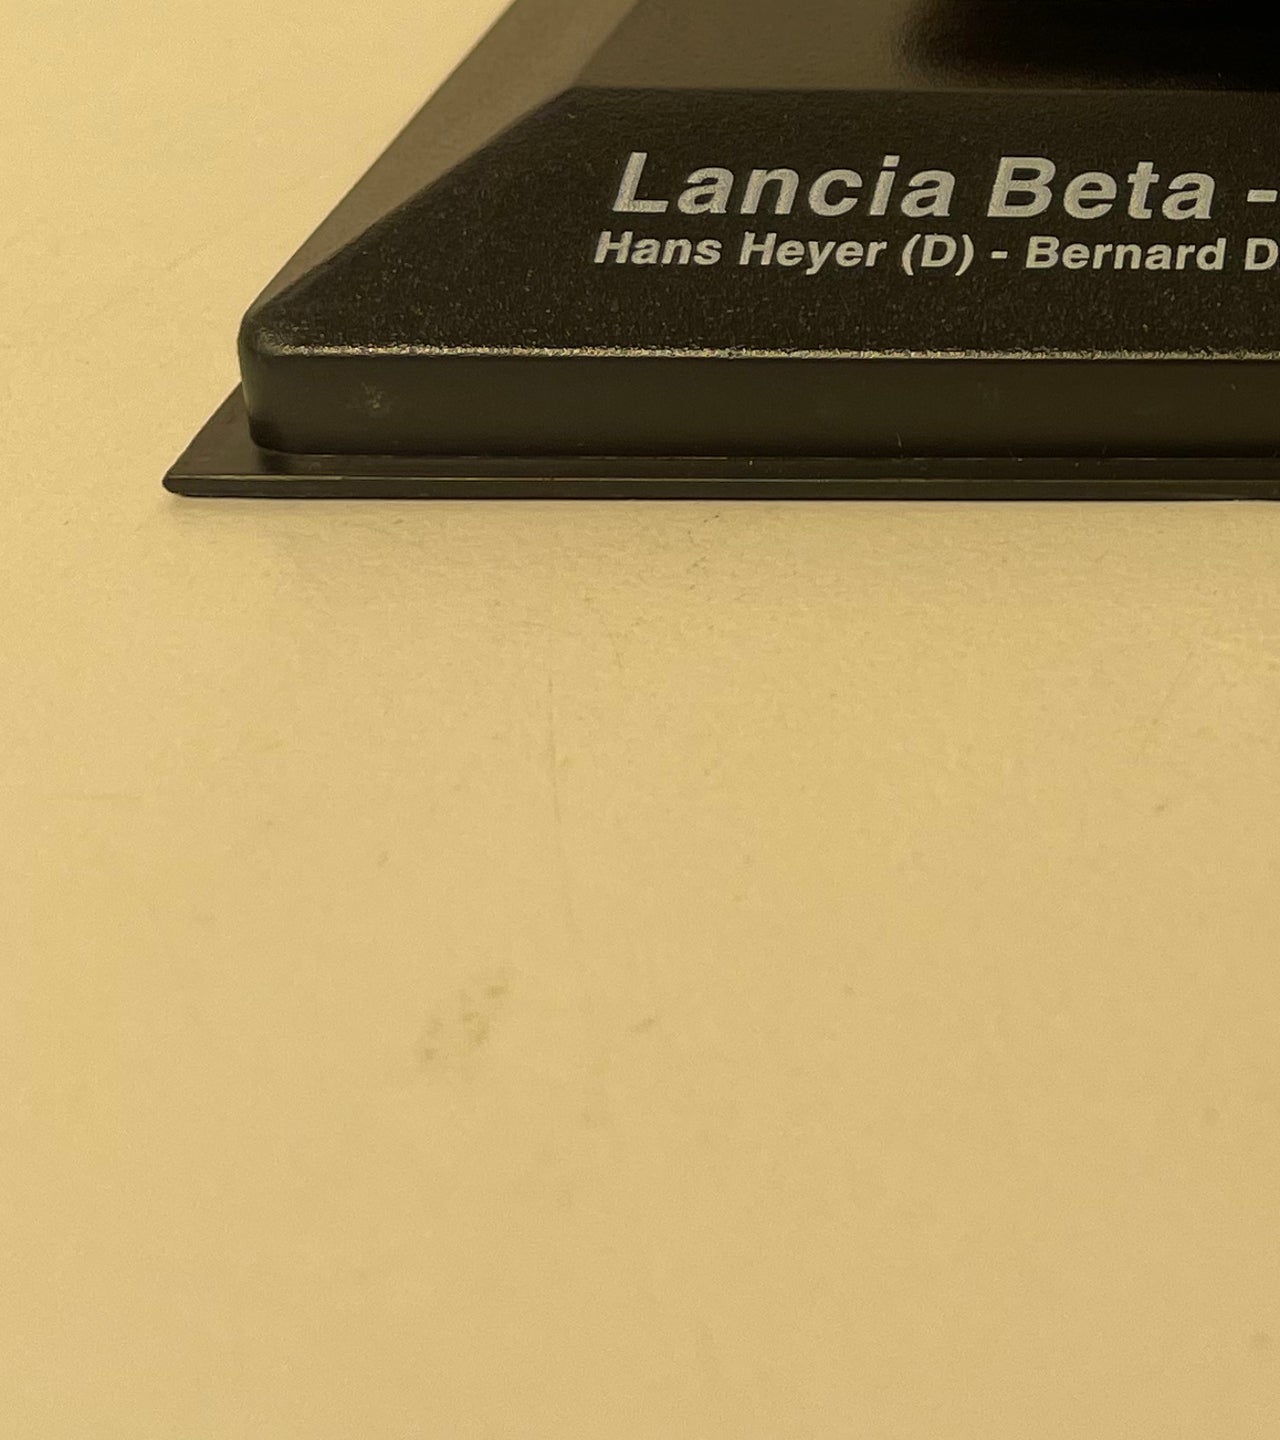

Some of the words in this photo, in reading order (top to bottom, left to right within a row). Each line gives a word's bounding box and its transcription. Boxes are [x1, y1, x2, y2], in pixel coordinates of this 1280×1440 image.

[612, 151, 956, 218] Lancia
[987, 156, 1216, 220] Beta
[1247, 189, 1278, 203] -
[594, 231, 722, 266] Hans
[739, 231, 888, 276] Heyer
[901, 233, 974, 276] (D)
[991, 250, 1009, 260] -
[1025, 235, 1227, 271] Bernard
